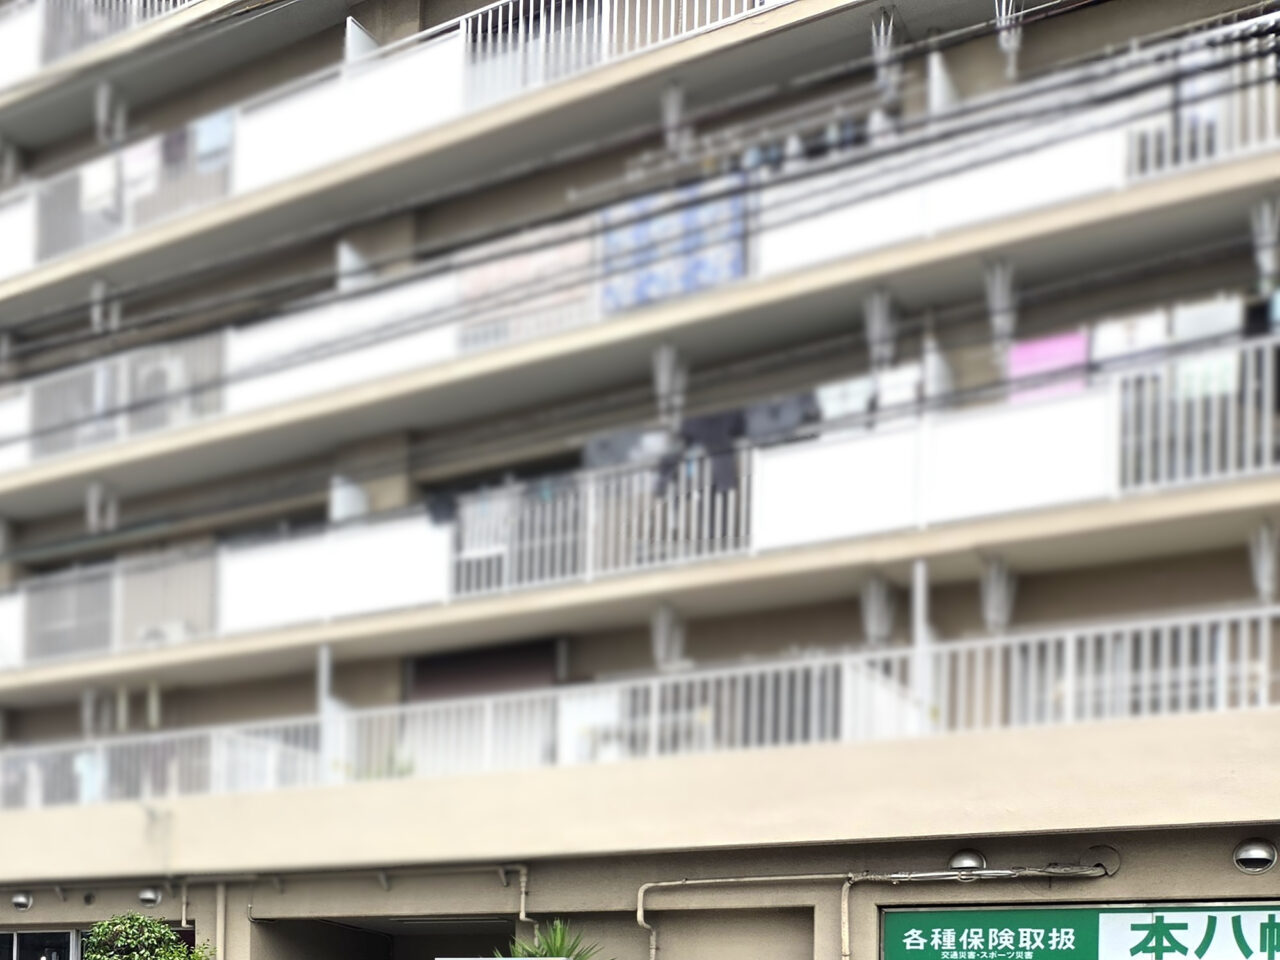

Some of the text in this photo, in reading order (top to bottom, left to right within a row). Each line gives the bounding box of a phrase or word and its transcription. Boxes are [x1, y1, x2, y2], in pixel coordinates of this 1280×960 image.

[902, 928, 1076, 950] 各種保険取扱
[940, 950, 1034, 960] 交通災害・スポーツ災害
